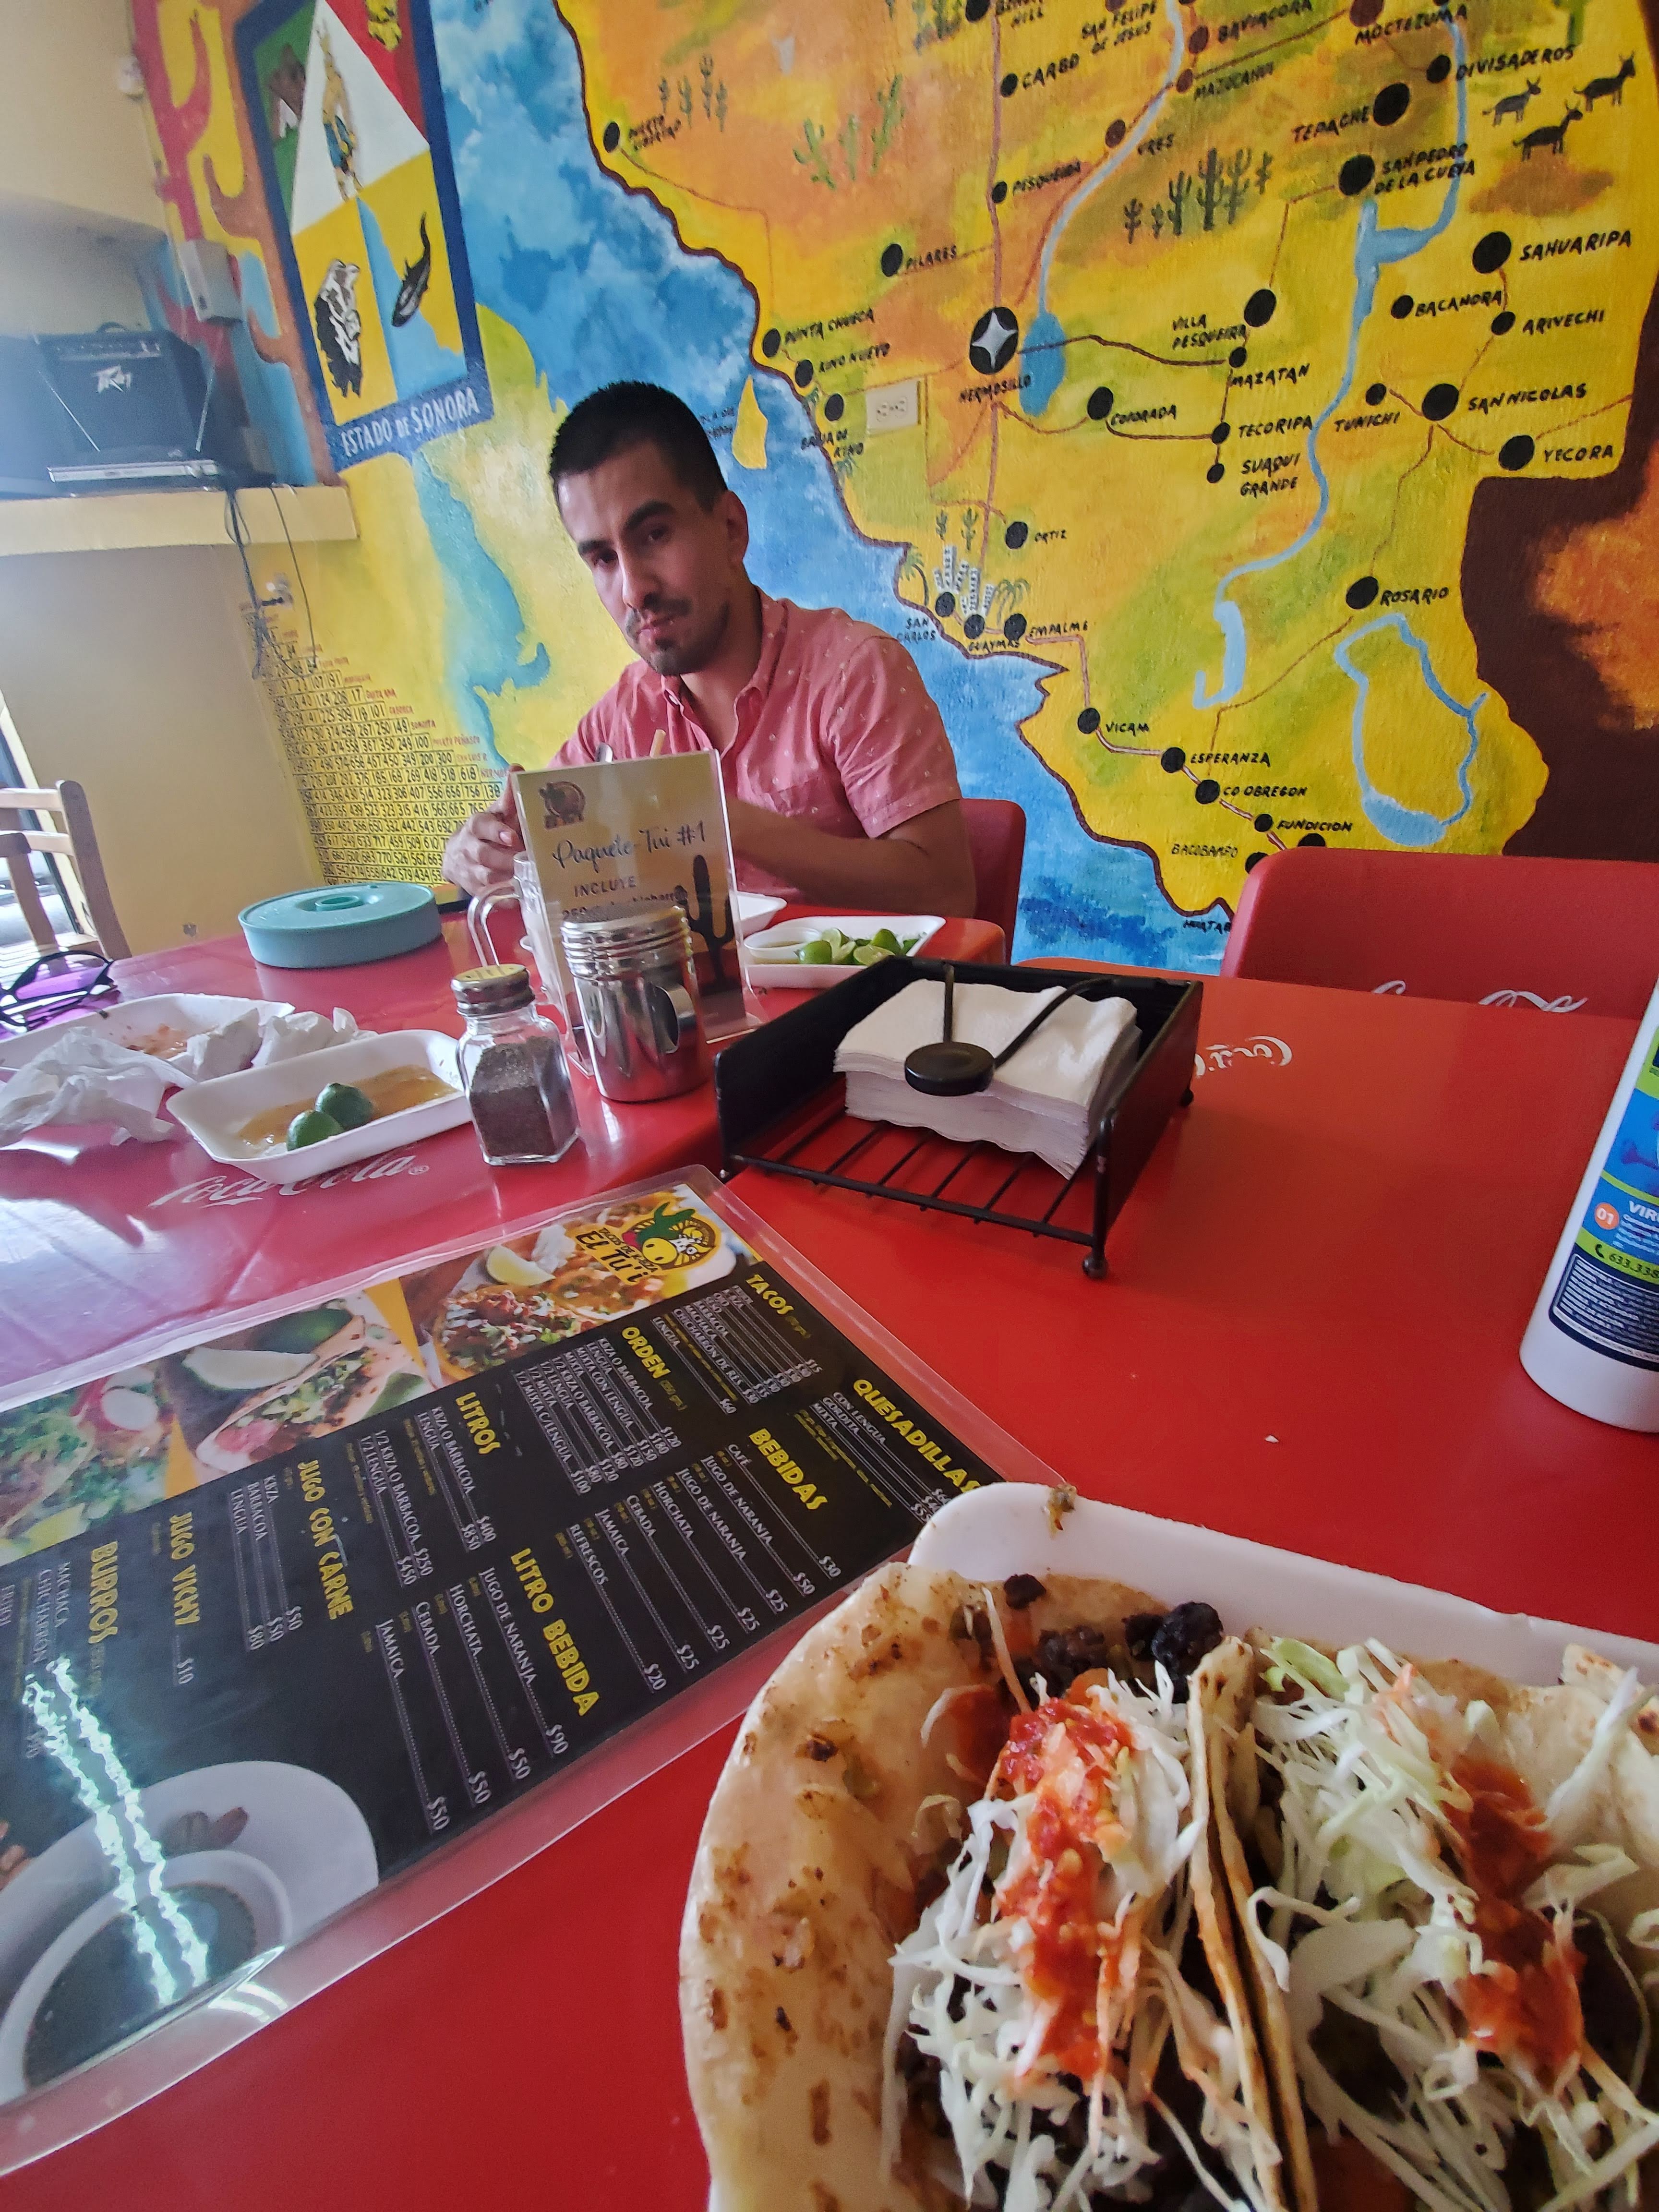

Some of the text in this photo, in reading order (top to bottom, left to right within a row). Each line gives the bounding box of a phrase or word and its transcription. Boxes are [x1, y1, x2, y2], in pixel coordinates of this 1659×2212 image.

[1023, 53, 1079, 90] CARBO
[1456, 45, 1575, 81] DIVISADEROS
[1292, 106, 1370, 143] TEPACHE
[1519, 229, 1632, 262] SAHUARIPA
[1414, 290, 1503, 317] BACANORA
[1522, 309, 1605, 335] ARIVECHI
[341, 419, 394, 457] ESTADO
[410, 386, 481, 433] SONORA
[1238, 414, 1312, 439] TECORIPA
[1543, 444, 1614, 463] YECORA
[1240, 476, 1298, 499] GRANDE
[1380, 586, 1449, 606] ROSARIO
[392, 720, 408, 734] 149
[397, 736, 412, 751] 249
[414, 735, 429, 748] 100
[1105, 721, 1150, 737] VICAM
[423, 768, 437, 781] 418
[441, 768, 457, 781] 518
[460, 767, 476, 781] 618
[437, 753, 452, 766] 300
[1190, 752, 1271, 768] ESPERANZA
[445, 784, 501, 800] 656 756 138
[449, 801, 466, 816] 665
[1244, 786, 1308, 797] OBREGON
[419, 819, 452, 834] 543 692
[422, 836, 439, 850] 610
[1276, 818, 1353, 832] FUNDICION
[552, 833, 635, 874] Paquete
[677, 819, 705, 847] #1
[415, 869, 430, 881] 434
[573, 875, 637, 898] INCLUYE
[1596, 1207, 1615, 1226] 01
[746, 1274, 794, 1315] TACOS
[653, 1316, 681, 1346] LENGUA
[587, 1342, 613, 1375] LENGUA
[622, 1326, 672, 1379] ORDEN
[576, 1346, 597, 1373] MIXTA
[591, 1372, 611, 1391] CON
[604, 1392, 635, 1428] LENGUA
[618, 1365, 654, 1410] BARBACOA
[661, 1426, 682, 1448] $120
[455, 1391, 501, 1455] LITROS
[547, 1374, 620, 1482] LENGUA $120
[561, 1369, 581, 1392] KBZA
[578, 1399, 615, 1448] BARBACOA
[565, 1351, 644, 1467] MIXTA $120
[814, 1403, 839, 1429] MIXTA
[833, 1392, 887, 1445] CON LENGUA
[417, 1411, 441, 1453] LENGUA
[522, 1384, 545, 1412] MIXTA
[571, 1469, 592, 1494] $100
[854, 1379, 981, 1493] QUESADILLAS
[380, 1445, 399, 1473] KBZA
[388, 1471, 402, 1482] O
[749, 1428, 829, 1510] BEBIDAS
[445, 1439, 476, 1495] BARBACOA
[476, 1515, 497, 1543] $400
[700, 1455, 727, 1482] JUGO
[723, 1481, 739, 1497] DE
[733, 1497, 773, 1546] NARANJA
[365, 1452, 388, 1494] LENGUA
[398, 1555, 418, 1586] $450
[392, 1482, 422, 1546] BARBACOA
[297, 1459, 354, 1621] JUGO CON CARNE
[653, 1480, 760, 1632] HORCHATA $25
[675, 1468, 789, 1612] JUGO DE NARANJA $25
[230, 1488, 265, 1651] LENGUA $80
[247, 1481, 285, 1643] BARBACOA $50
[414, 1547, 434, 1577] $250
[626, 1494, 730, 1649] CEBADA $25
[818, 1555, 842, 1578] $30
[88, 1540, 119, 1645] BURROS
[169, 1512, 201, 1685] JUGO VICHY $10
[569, 1523, 609, 1586] REFRESCOS
[644, 1663, 667, 1691] $20
[595, 1508, 700, 1670] JAMAICA $25
[286, 1605, 304, 1631] $50
[510, 1547, 600, 1717] LITRO BEBIDA
[478, 1565, 570, 1755] JUGO DE NARANJA $90
[449, 1583, 484, 1657] HORCHATA
[508, 1747, 531, 1780] $50
[415, 1600, 441, 1656] CEBADA
[468, 1770, 492, 1805] $50
[375, 1618, 451, 1831] JAMAICA $50
